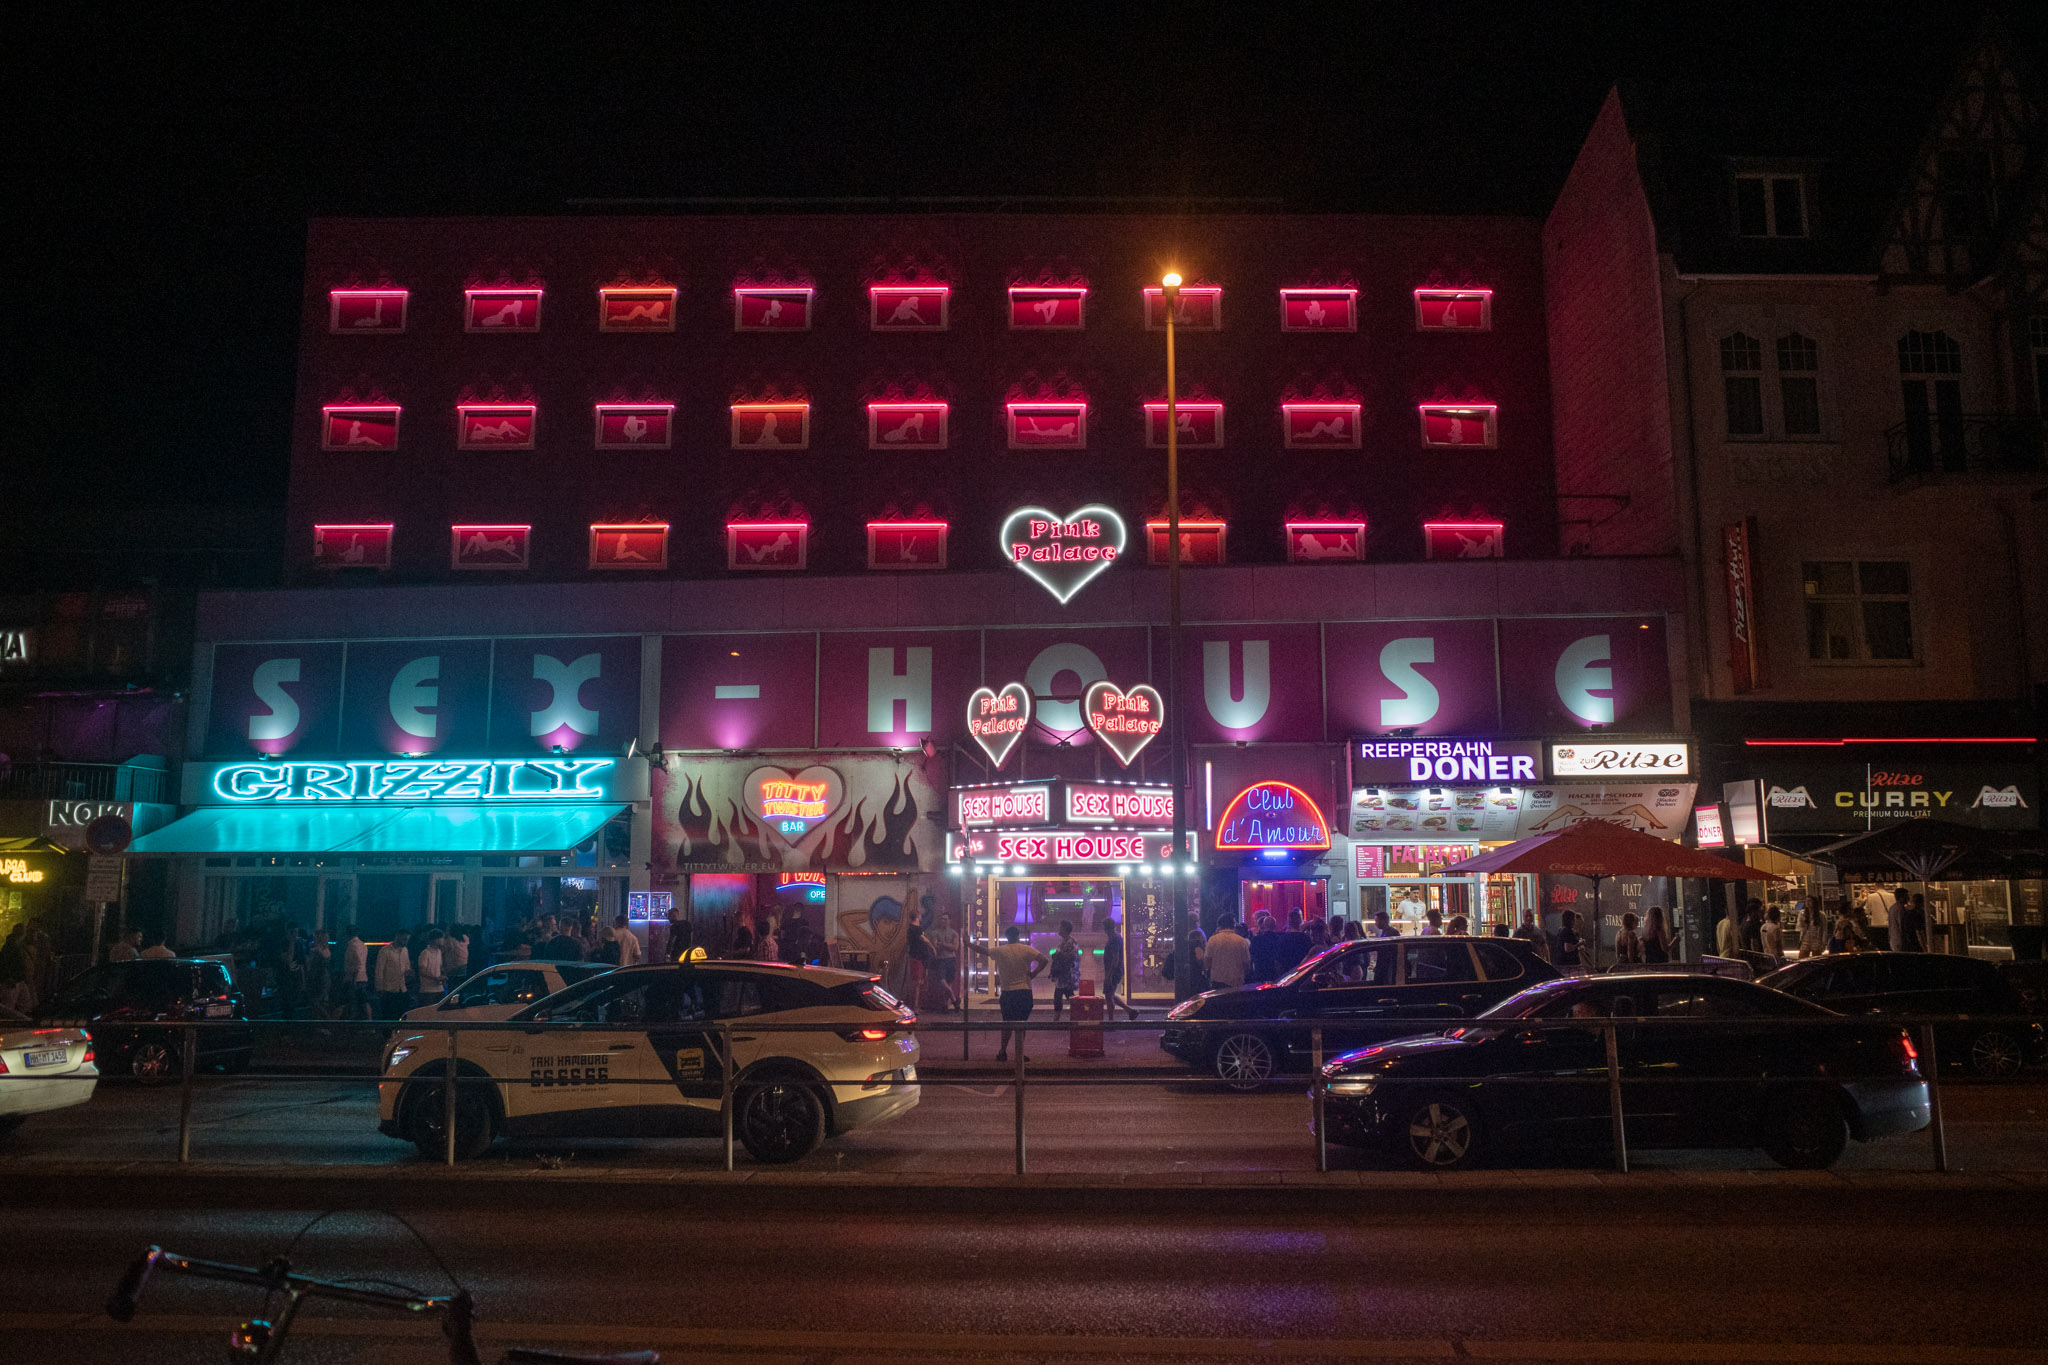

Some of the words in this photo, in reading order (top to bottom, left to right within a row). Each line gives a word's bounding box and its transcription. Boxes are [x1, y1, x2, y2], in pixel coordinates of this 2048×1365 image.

[1030, 519, 1100, 539] Pink
[1012, 543, 1117, 563] Palace
[1729, 534, 1741, 581] Hut
[1735, 584, 1747, 643] Pizza
[981, 695, 1017, 715] Pink
[1104, 692, 1150, 712] Pink
[971, 718, 1025, 736] Palace
[1092, 713, 1160, 733] Palace
[1361, 742, 1492, 758] REEPERBAHN
[1583, 750, 1683, 770] Ritze
[214, 760, 614, 801] GRIZZLY
[1868, 771, 1923, 787] Ritze
[764, 801, 824, 817] TWISTER
[963, 797, 989, 818] SEX
[992, 793, 1044, 817] HOUSE
[1073, 794, 1110, 816] SEX
[1115, 796, 1175, 818] HOUSE
[1247, 788, 1294, 810] Club
[1835, 791, 1953, 807] CURRY
[1853, 810, 1891, 818] PREMIUM
[1893, 809, 1932, 818] QUALITÄT
[782, 821, 804, 832] BAR
[1223, 818, 1324, 843] d'Amour
[999, 837, 1047, 859] SEX
[1056, 837, 1144, 859] HOUSE
[9, 871, 43, 882] CLUB
[1622, 883, 1642, 897] PLATZ
[1629, 902, 1637, 910] DER
[531, 1057, 553, 1067] TAXI
[557, 1055, 608, 1066] HAMBURG
